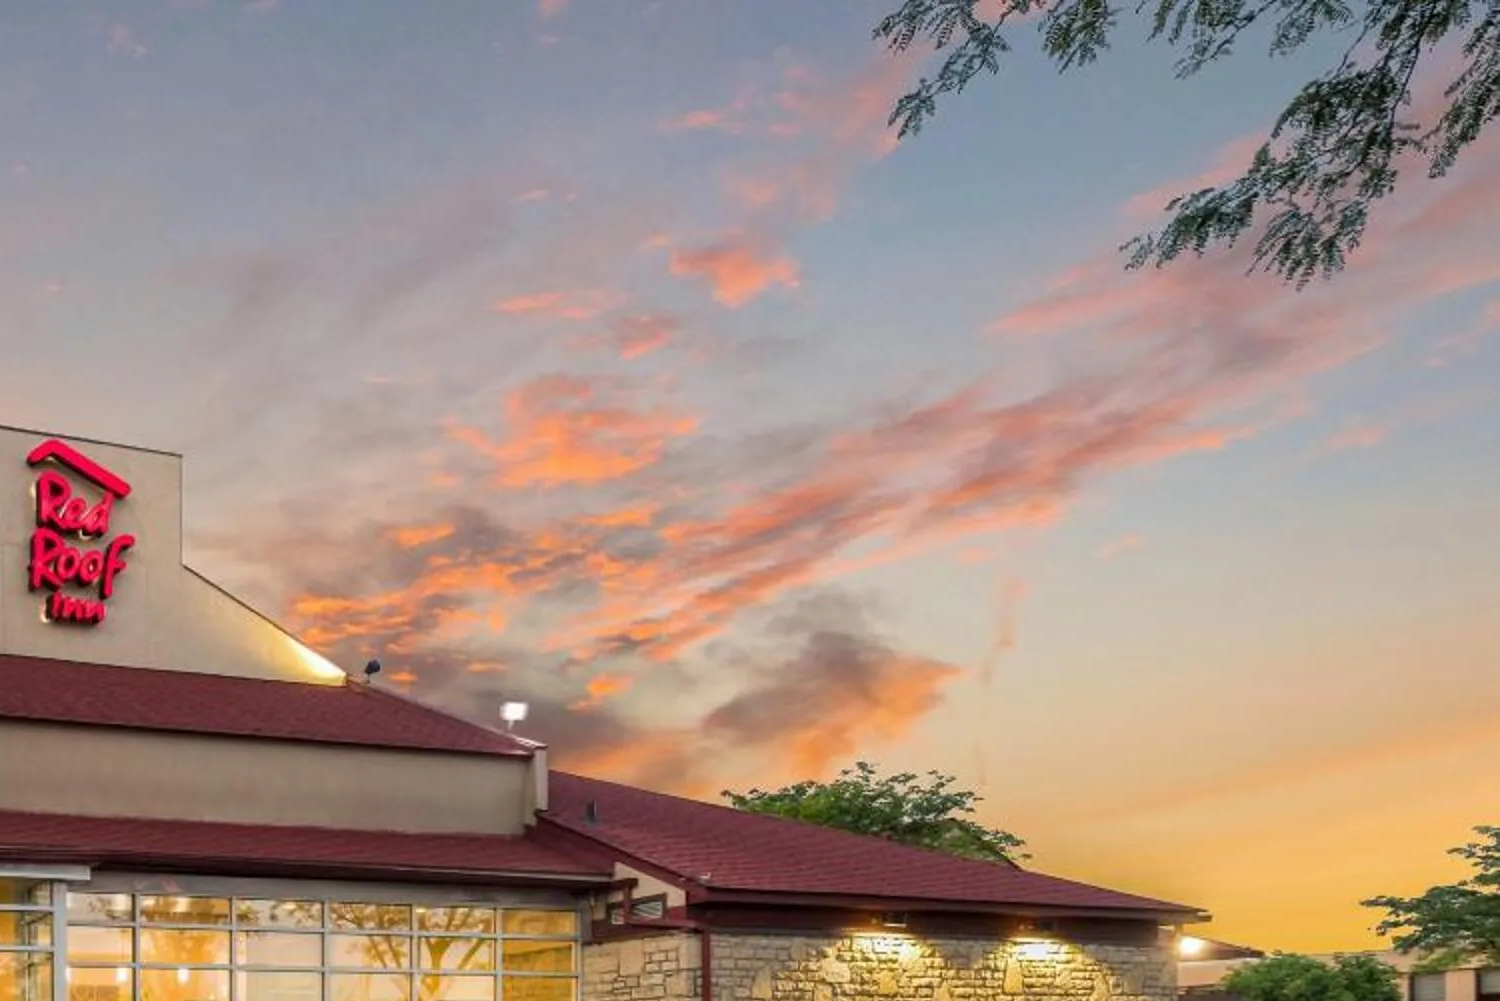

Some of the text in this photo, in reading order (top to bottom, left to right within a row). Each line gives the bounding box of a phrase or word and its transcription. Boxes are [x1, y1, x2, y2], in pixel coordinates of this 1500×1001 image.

[37, 470, 115, 535] Red
[29, 528, 136, 598] Roof
[49, 591, 107, 623] Inn
